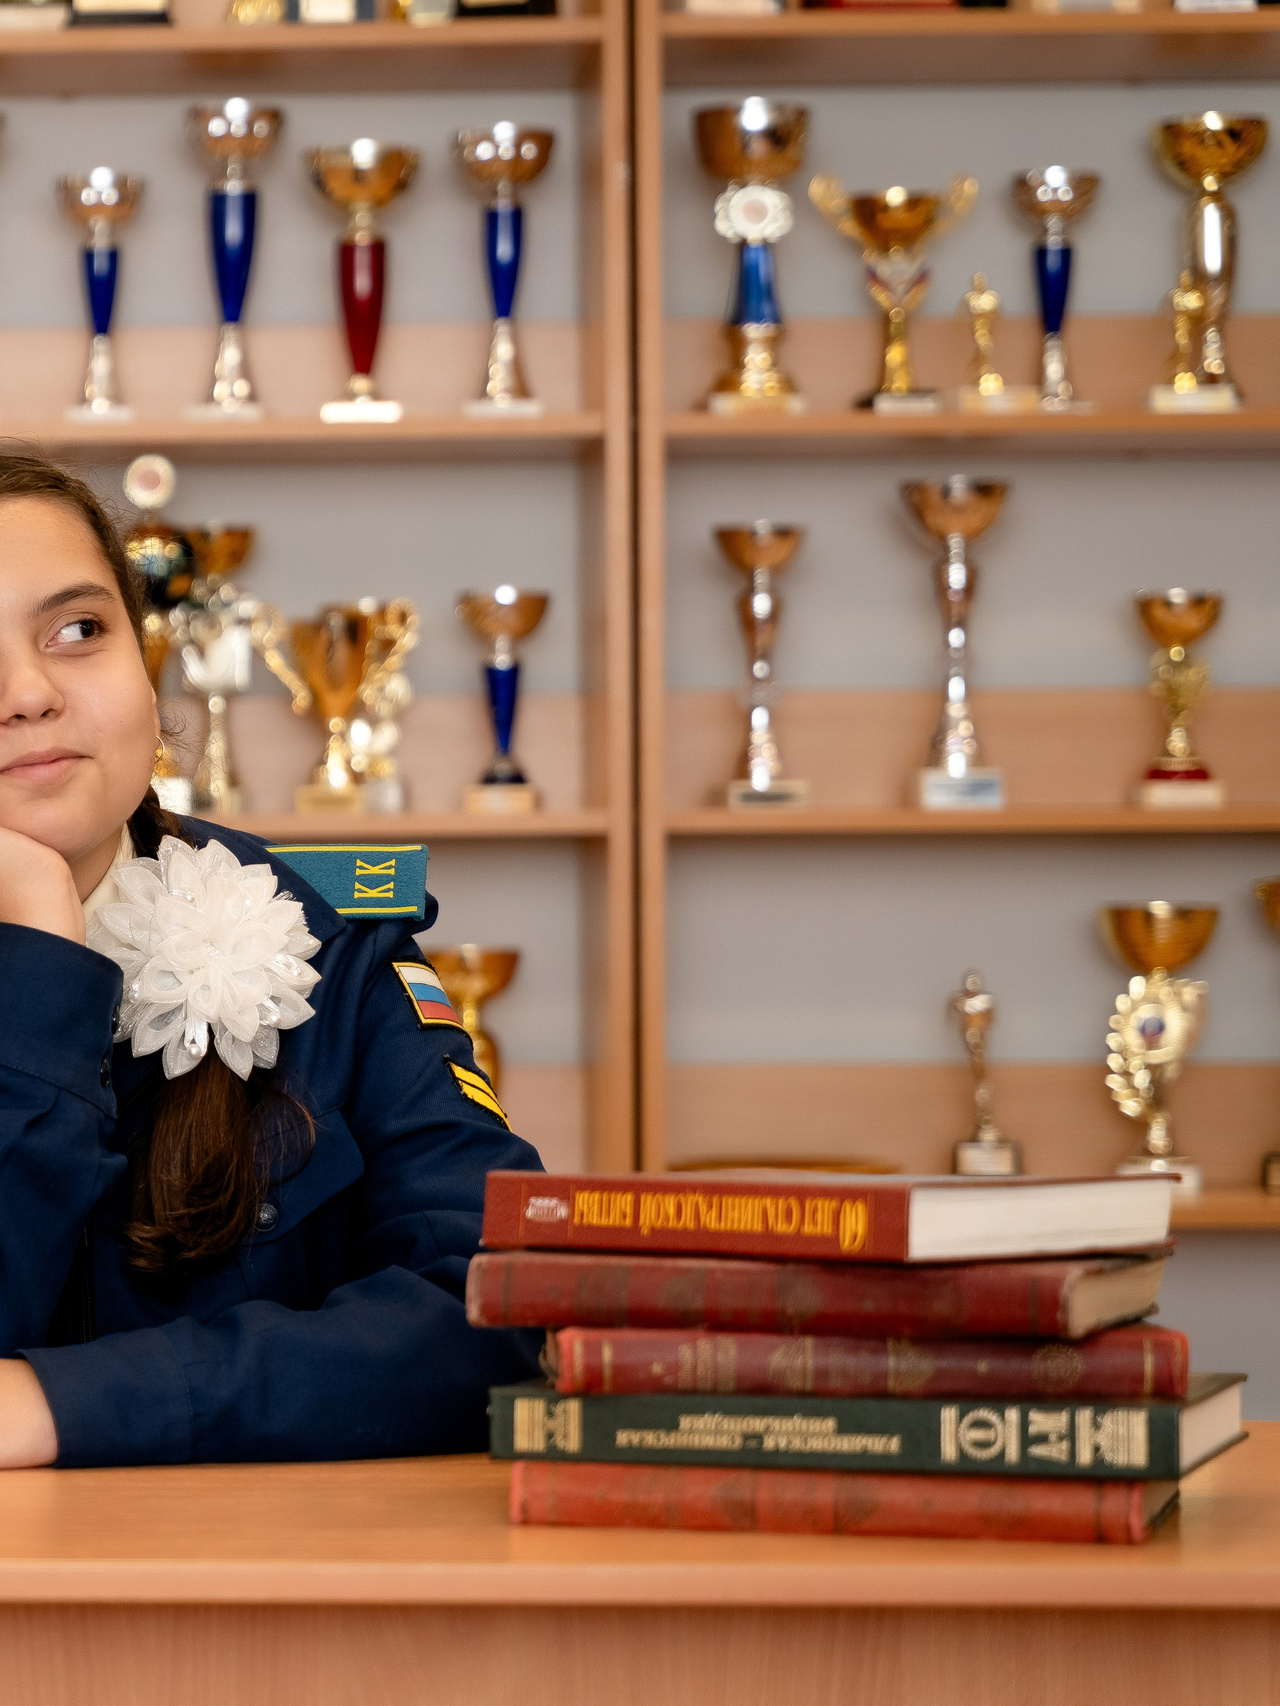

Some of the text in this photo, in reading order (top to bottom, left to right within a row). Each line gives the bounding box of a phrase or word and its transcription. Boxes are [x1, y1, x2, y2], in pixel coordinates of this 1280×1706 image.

[572, 1190, 634, 1228] БИТВЫ
[638, 1188, 801, 1237] СТАЛИНГРАДСКОЙ
[800, 1196, 839, 1236] ЛЕТ
[838, 1197, 868, 1253] 60
